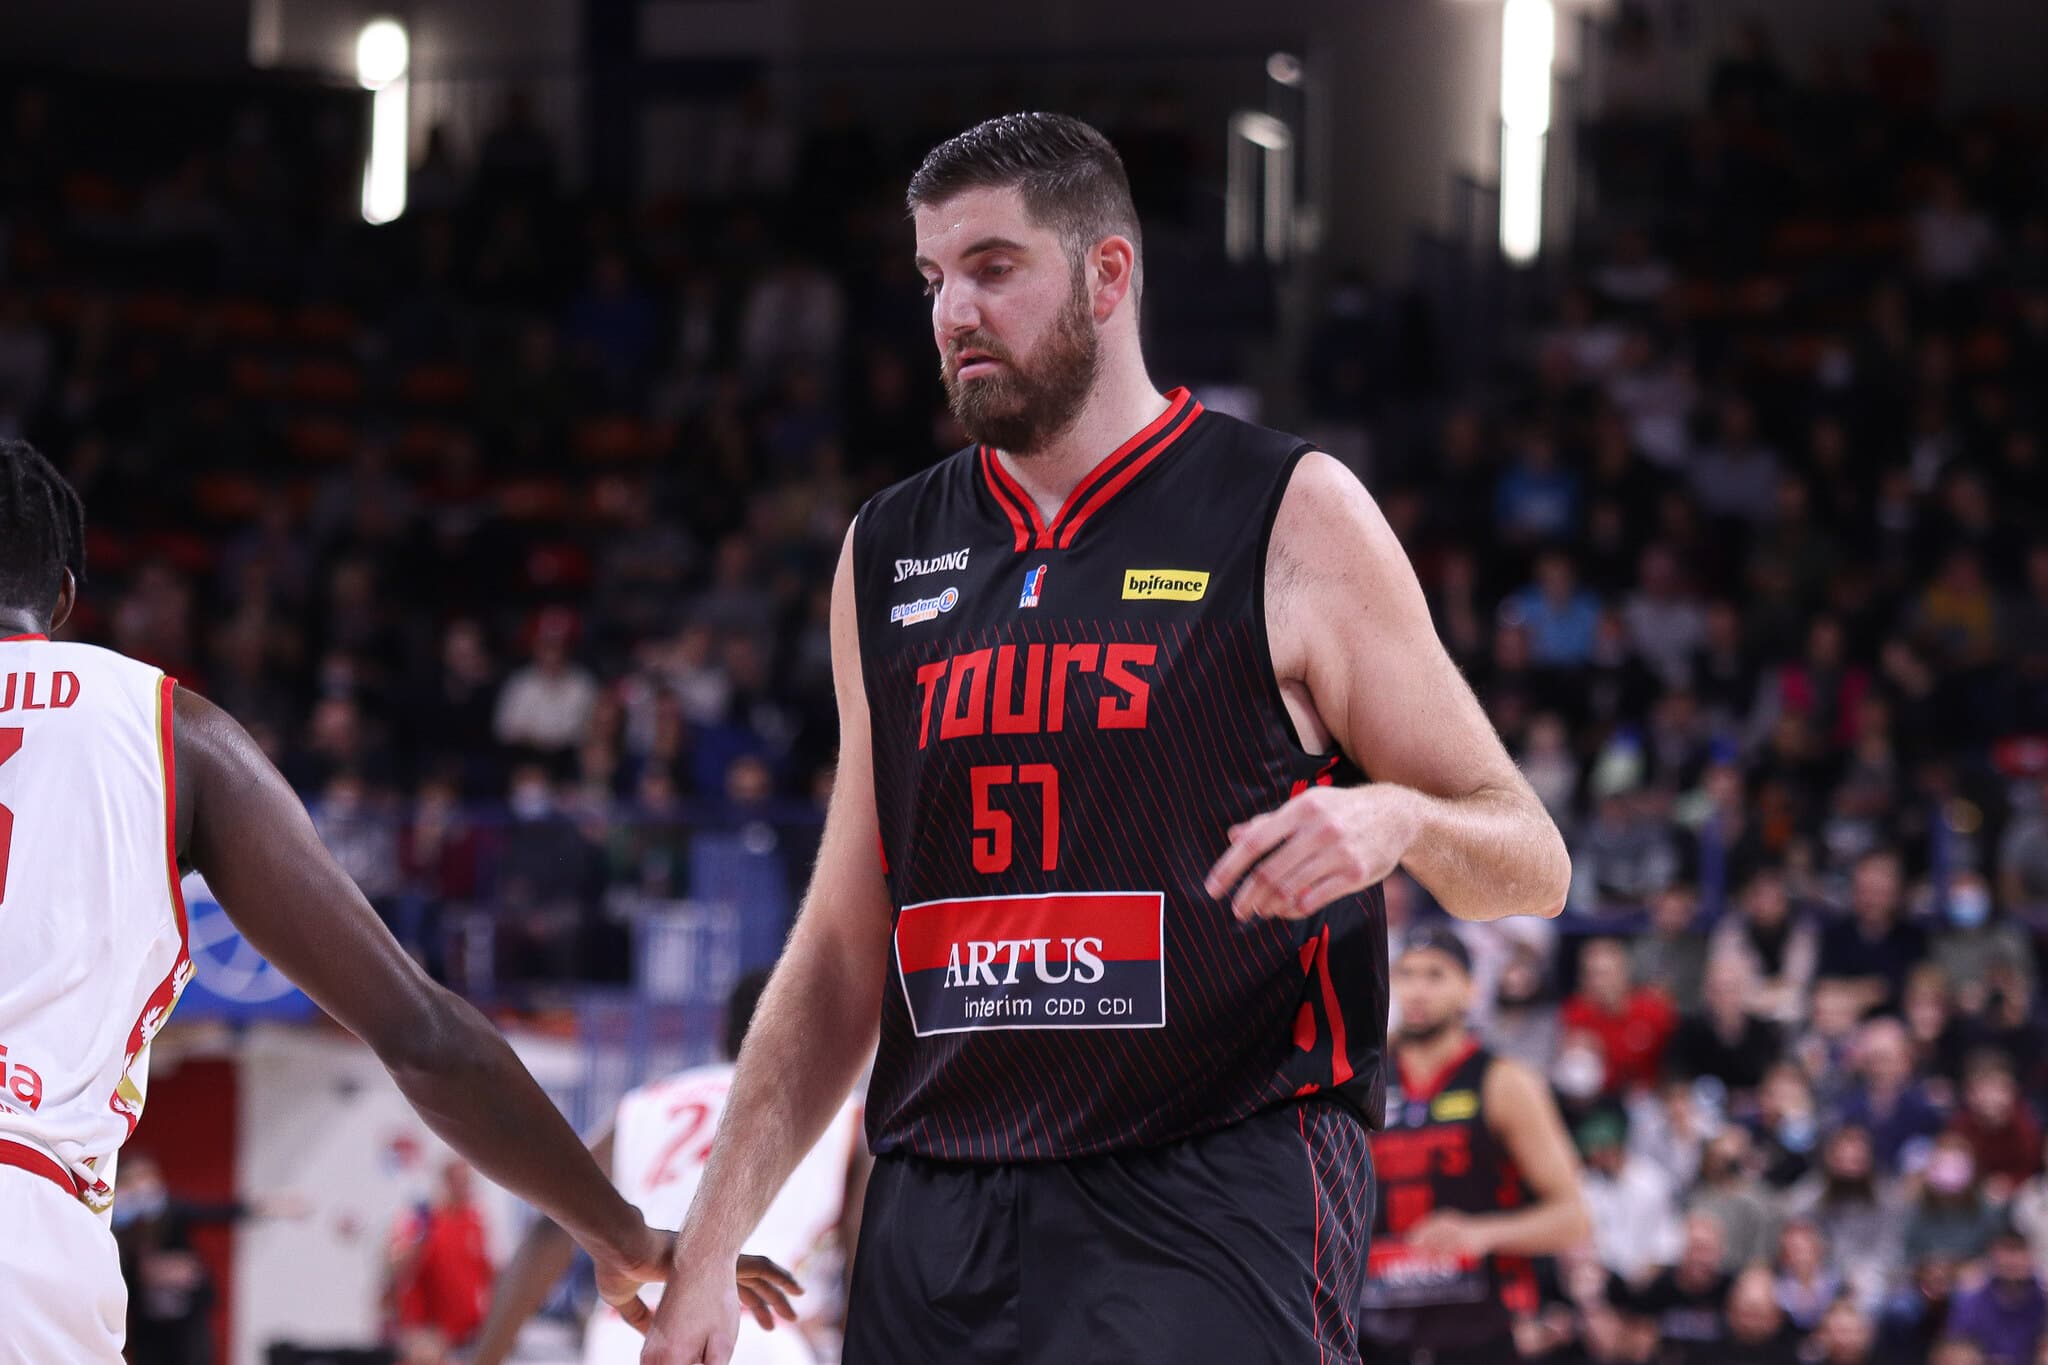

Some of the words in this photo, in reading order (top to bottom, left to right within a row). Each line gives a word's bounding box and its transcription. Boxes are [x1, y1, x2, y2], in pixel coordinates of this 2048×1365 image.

[894, 548, 970, 583] SPALDING
[1129, 575, 1203, 595] bpifrance
[1020, 596, 1038, 608] LNB
[970, 763, 1060, 874] 57
[943, 937, 1105, 988] ARTUS
[965, 994, 1032, 1018] interim
[1044, 998, 1086, 1016] CDD
[1097, 997, 1133, 1015] CDI
